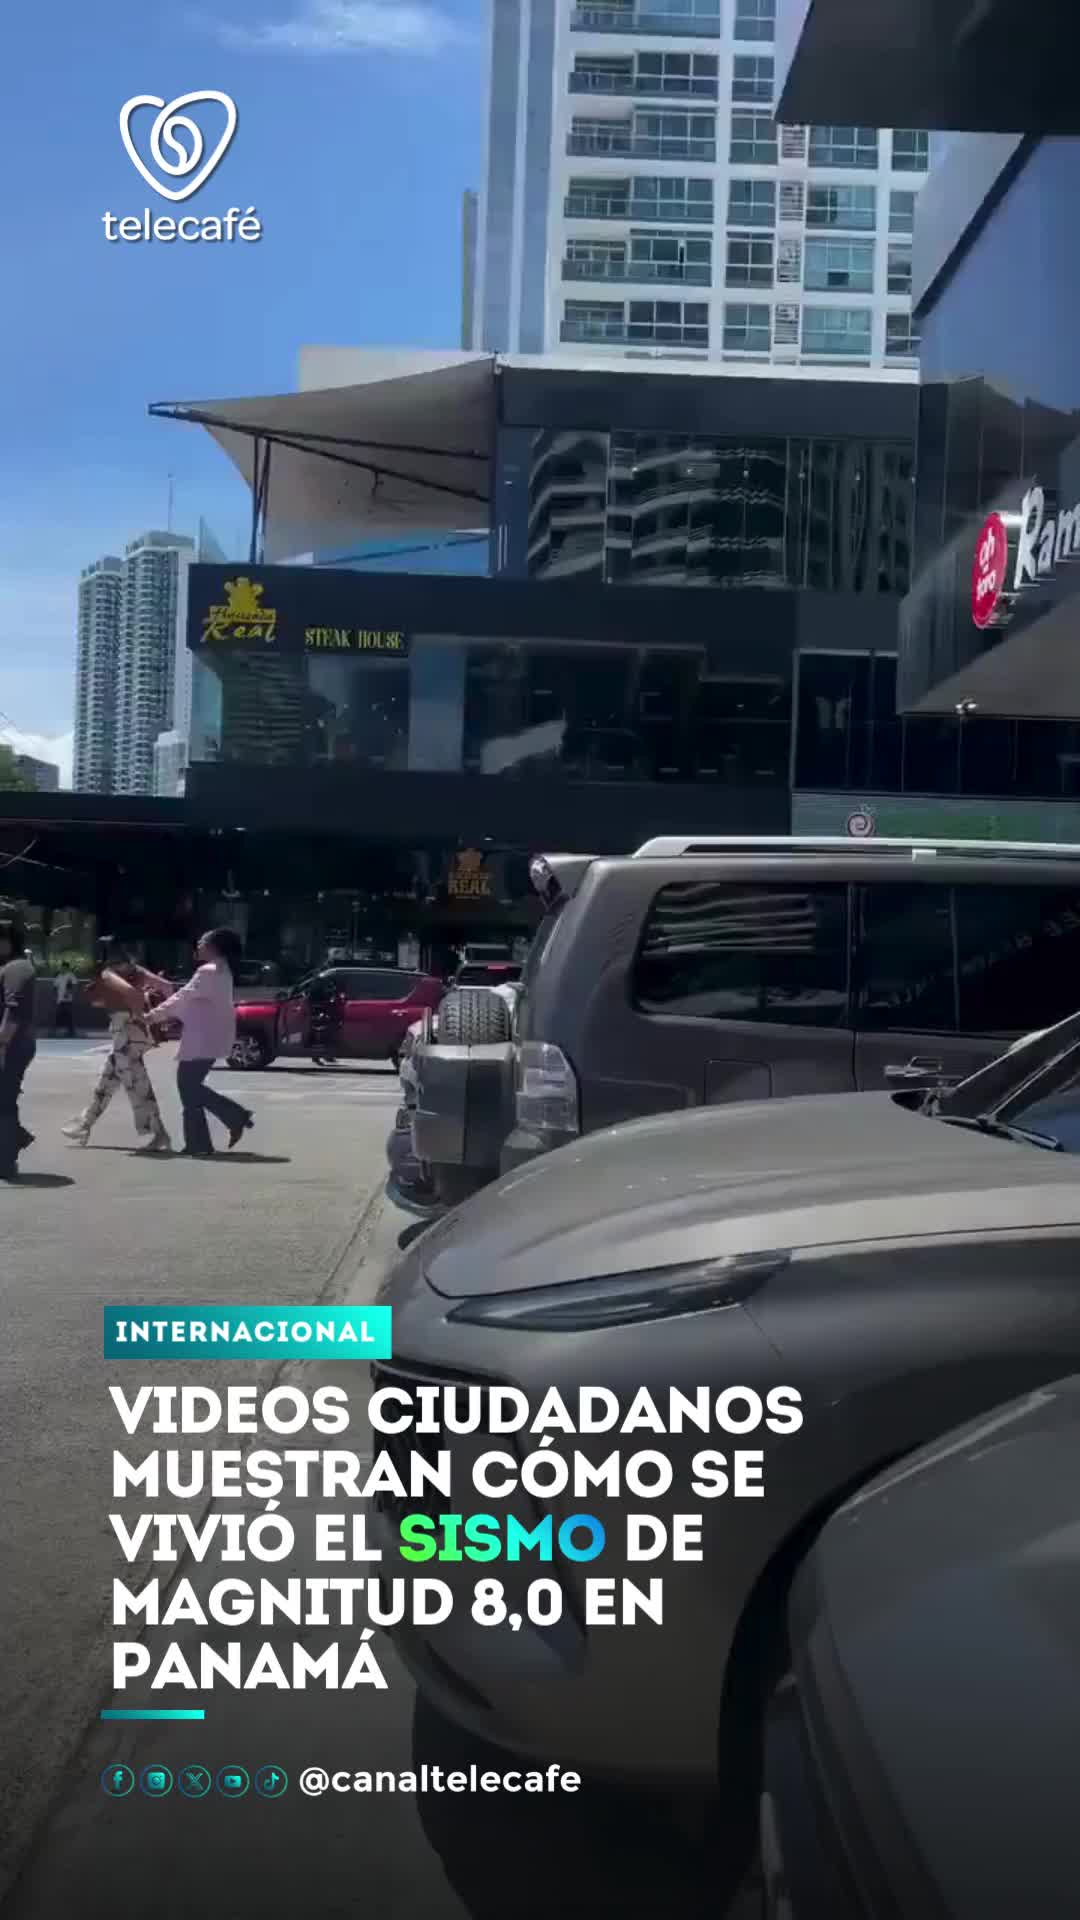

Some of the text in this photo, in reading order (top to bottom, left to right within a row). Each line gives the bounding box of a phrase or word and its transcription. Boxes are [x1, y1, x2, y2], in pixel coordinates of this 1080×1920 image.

[200, 621, 277, 643] Real
[304, 626, 404, 649] STEAK HOUSE
[448, 880, 490, 896] REAL
